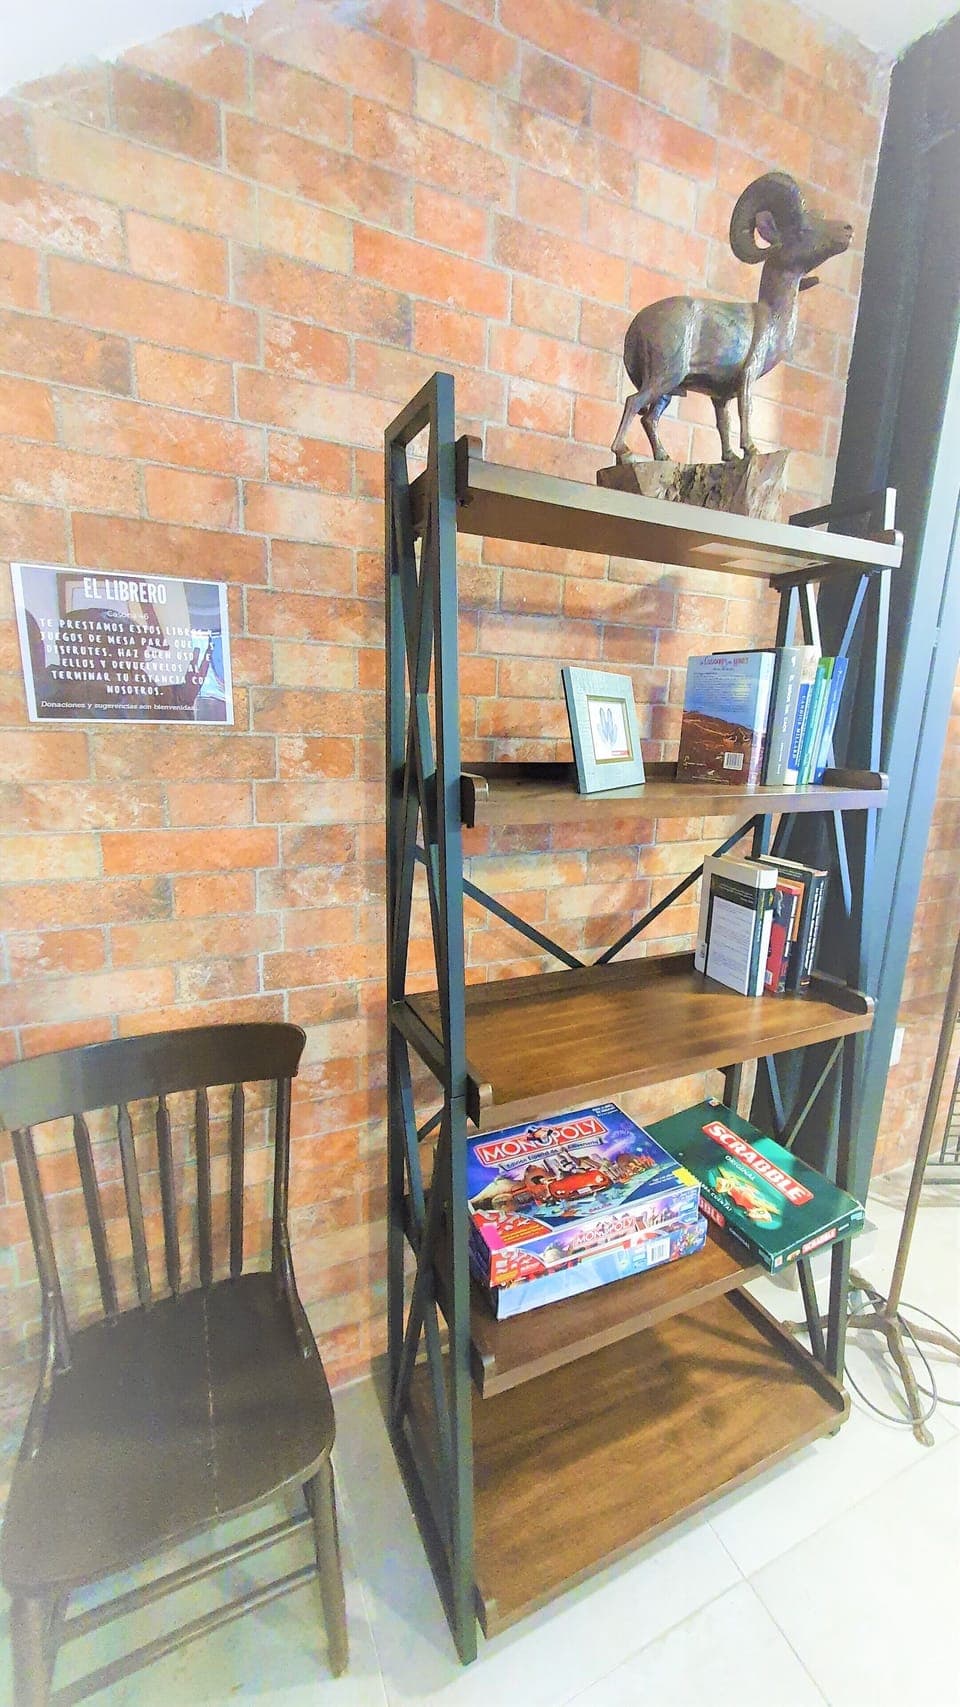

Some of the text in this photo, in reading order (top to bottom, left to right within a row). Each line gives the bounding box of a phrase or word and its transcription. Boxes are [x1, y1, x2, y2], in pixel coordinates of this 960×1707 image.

[83, 577, 167, 605] EL LIBRERO
[40, 618, 54, 628] TE
[59, 619, 124, 633] PRESTAMOS
[129, 624, 161, 635] ESTOS
[41, 631, 83, 643] JUEGOS
[89, 633, 102, 644] DE
[107, 635, 135, 646] MESA
[141, 638, 169, 648] PARA
[174, 639, 192, 649] QUE
[46, 645, 113, 657] DISFRUTES.
[117, 648, 139, 659] HAZ
[144, 650, 171, 660] BUEN
[176, 652, 194, 661] USO
[62, 658, 199, 674] ELLOS Y DEVUELVELOS AL
[51, 670, 210, 686] TERMINAR TU ESTANCIA CO
[107, 685, 165, 696] NOSOTROS.
[41, 700, 87, 710] Donaciones
[94, 703, 138, 711] sugerencias
[482, 1119, 597, 1161] MONOPOLY
[708, 1124, 806, 1200] SCRABBLE
[725, 1155, 756, 1181] ORIGINAL
[576, 1217, 635, 1245] MONOPOLY
